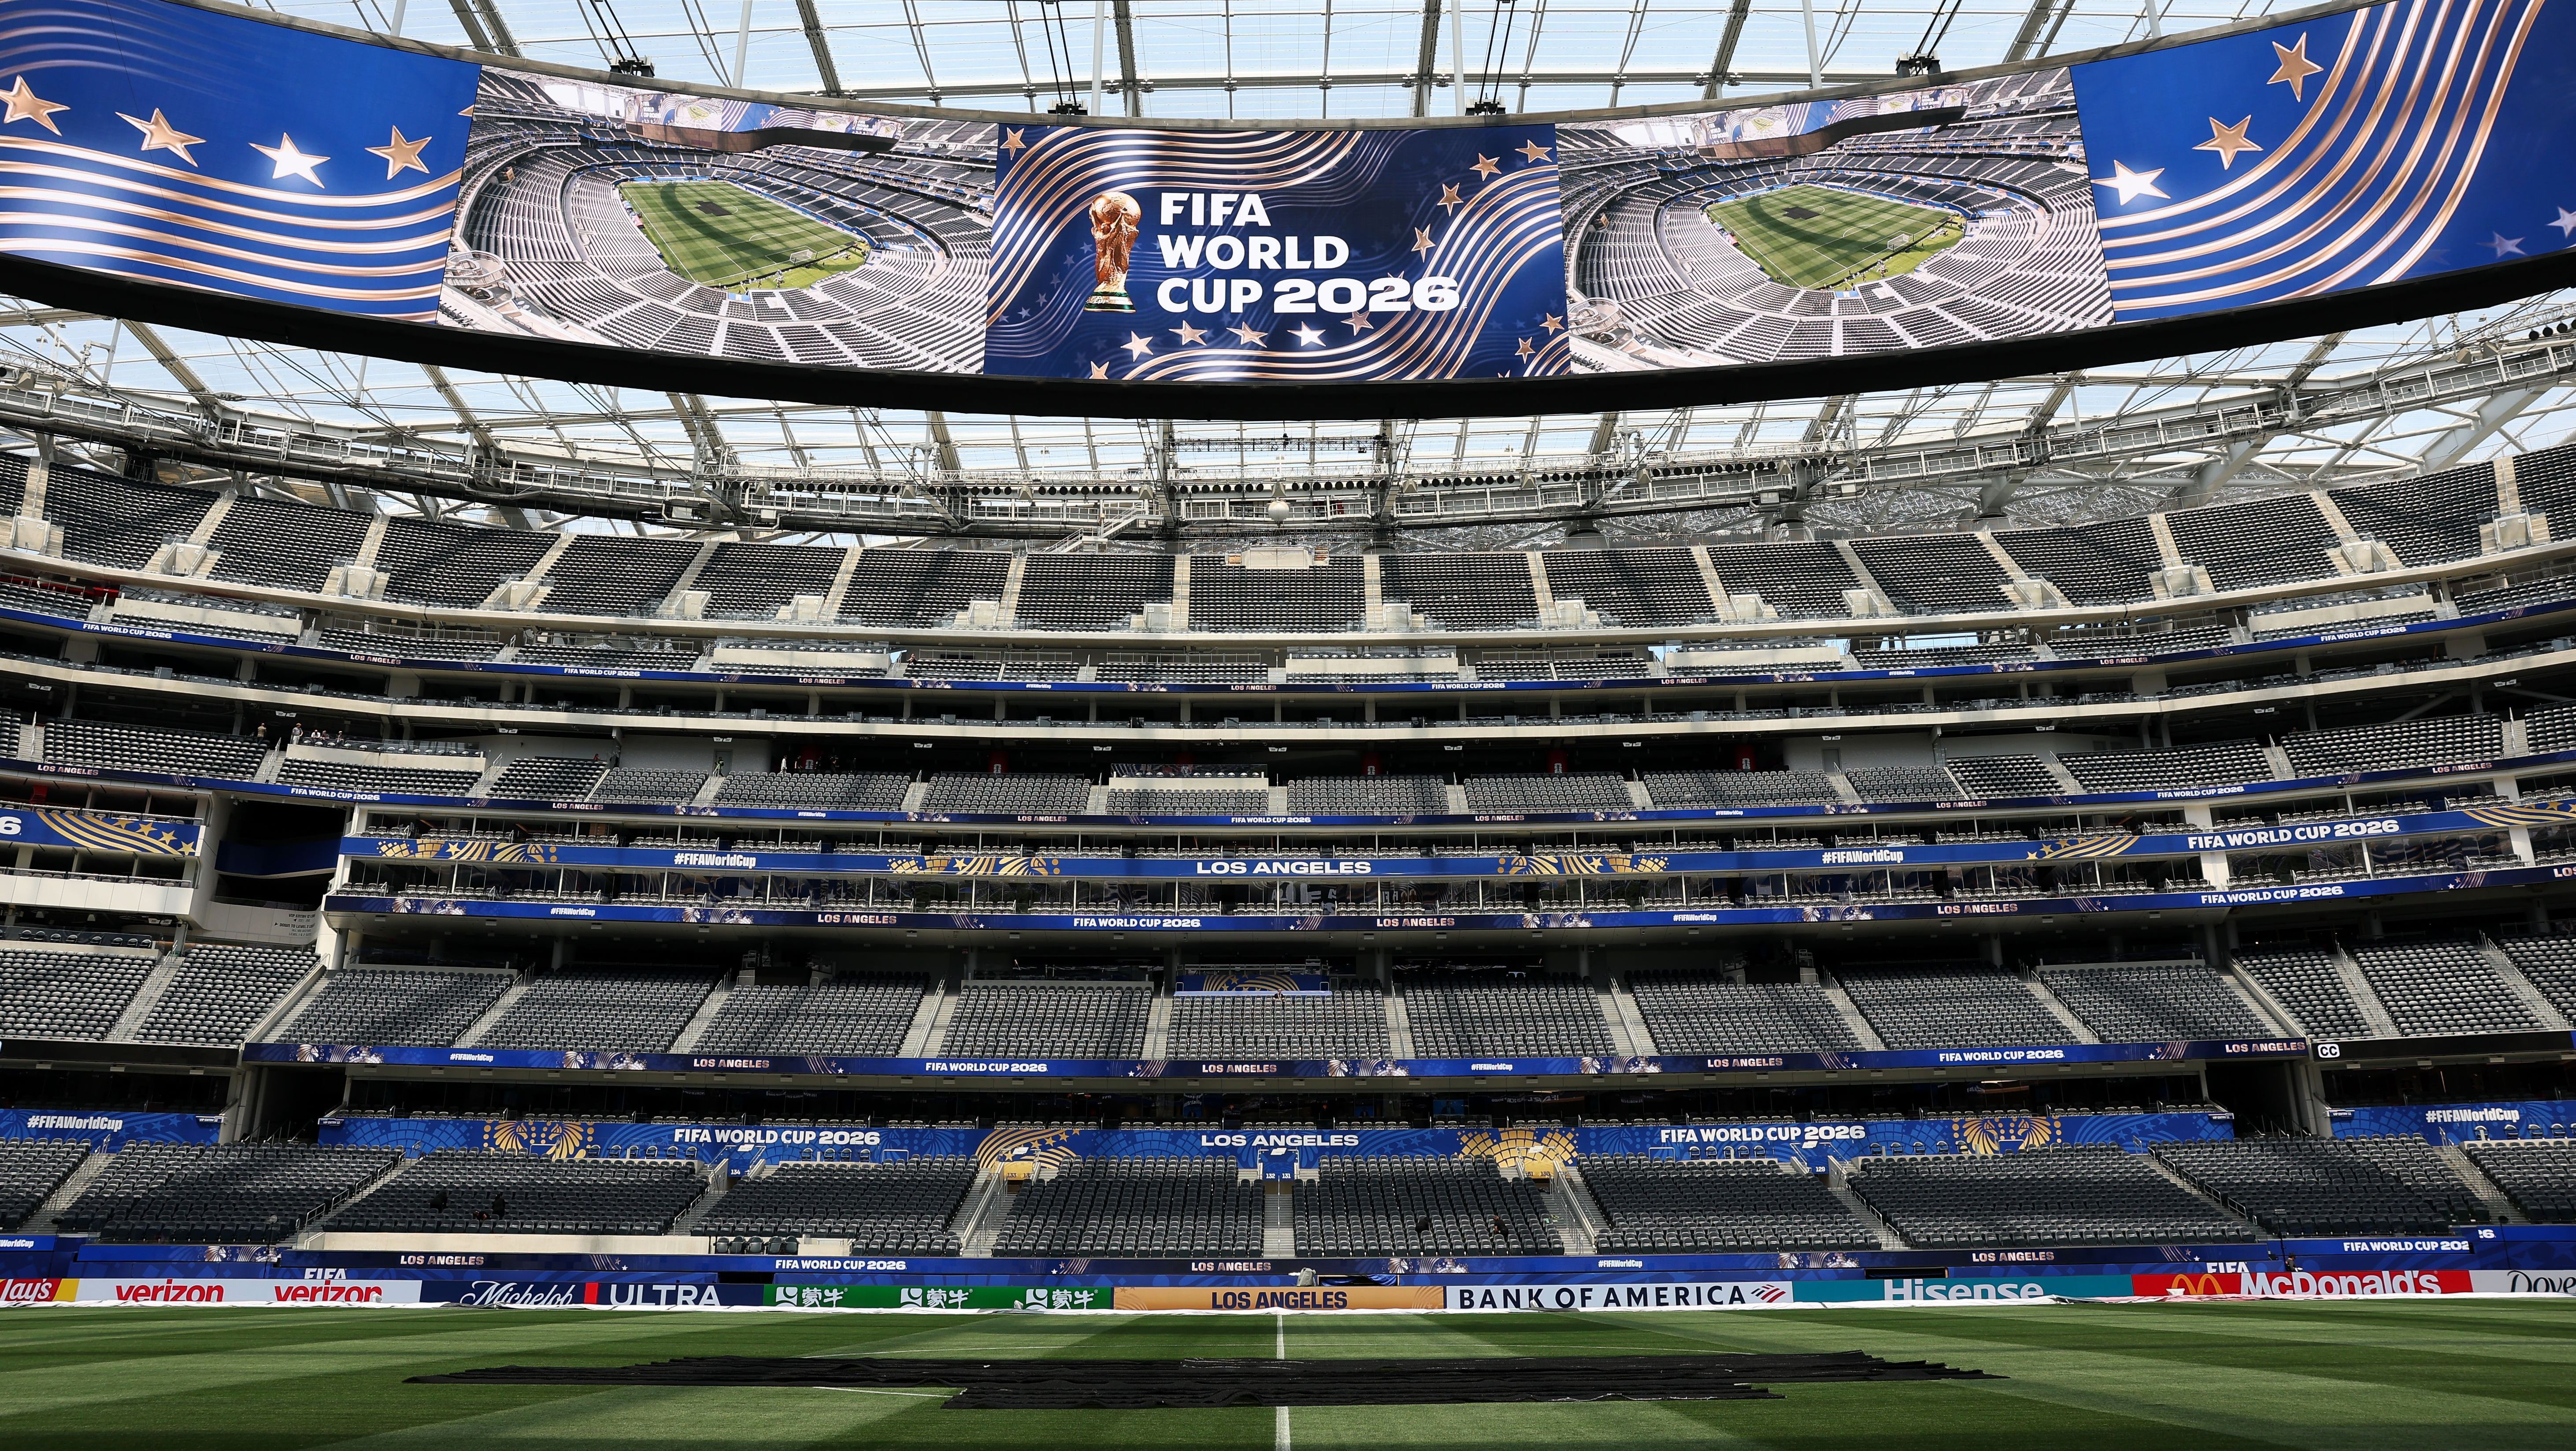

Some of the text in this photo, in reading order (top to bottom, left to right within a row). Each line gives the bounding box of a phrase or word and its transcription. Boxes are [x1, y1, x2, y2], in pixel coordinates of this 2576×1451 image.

[1160, 192, 1271, 226] FIFA
[1157, 234, 1349, 269] WORLD
[1157, 276, 1460, 313] CUP 2026
[367, 656, 400, 664] ANGELES
[2188, 820, 2398, 849] FIFA WORLD CUP 2026
[675, 853, 756, 869] #FIFAWorldCup
[1822, 850, 1903, 863] #FIFAWorldCup
[1197, 862, 1371, 874] LOS ANGELES
[2202, 886, 2343, 903] FIFA WORLD CUP 2026
[551, 908, 595, 917] #FIFAWorldCup
[1938, 904, 2017, 914] LOS ANGELES
[844, 915, 896, 923] ANGELES
[1163, 919, 1200, 927] 2026
[2225, 1042, 2305, 1052] LOS ANGELES
[2320, 1046, 2337, 1056] CC
[450, 1054, 493, 1062] #FIFAWorldCup
[1732, 1058, 1782, 1066] ANGELES
[1963, 1052, 2001, 1061] WORLD
[2004, 1051, 2024, 1059] CUP
[2026, 1050, 2064, 1059] 2026
[719, 1059, 769, 1068] ANGELES
[1011, 1063, 1047, 1072] 2026
[2426, 1108, 2520, 1122] #FIFAWorldCup
[27, 1116, 122, 1132] #FIFAWorldCup
[675, 1129, 880, 1145] FIFA WORLD CUP 2026
[1661, 1125, 1865, 1142] FIFA WORLD CUP 2026
[1202, 1135, 1358, 1146] LOS ANGELES
[2343, 1242, 2369, 1251] FIFA
[2370, 1242, 2413, 1251] WORLD
[2415, 1241, 2438, 1250] CUP
[400, 1255, 484, 1265] LOS ANGELES
[1972, 1252, 2054, 1262] LOS ANGELES
[776, 1260, 906, 1270] FIFA WORLD CUP 2026
[1192, 1262, 1271, 1271] LOS ANGELES
[2206, 1262, 2250, 1273] FIFA
[304, 1268, 346, 1279] FIFA
[2240, 1270, 2442, 1295] McDonald's
[2507, 1270, 2576, 1293] Dove
[116, 1279, 224, 1302] verizon
[274, 1280, 382, 1302] verizon
[460, 1281, 720, 1306] Michelob ULTRA
[1884, 1279, 2044, 1300] Hisense
[802, 1287, 844, 1307] 蒙牛
[927, 1288, 969, 1309] 蒙牛
[1052, 1289, 1094, 1309] 蒙牛
[1212, 1292, 1347, 1308] LOS ANGELES
[1460, 1285, 1746, 1309] BANK OF AMERICA
